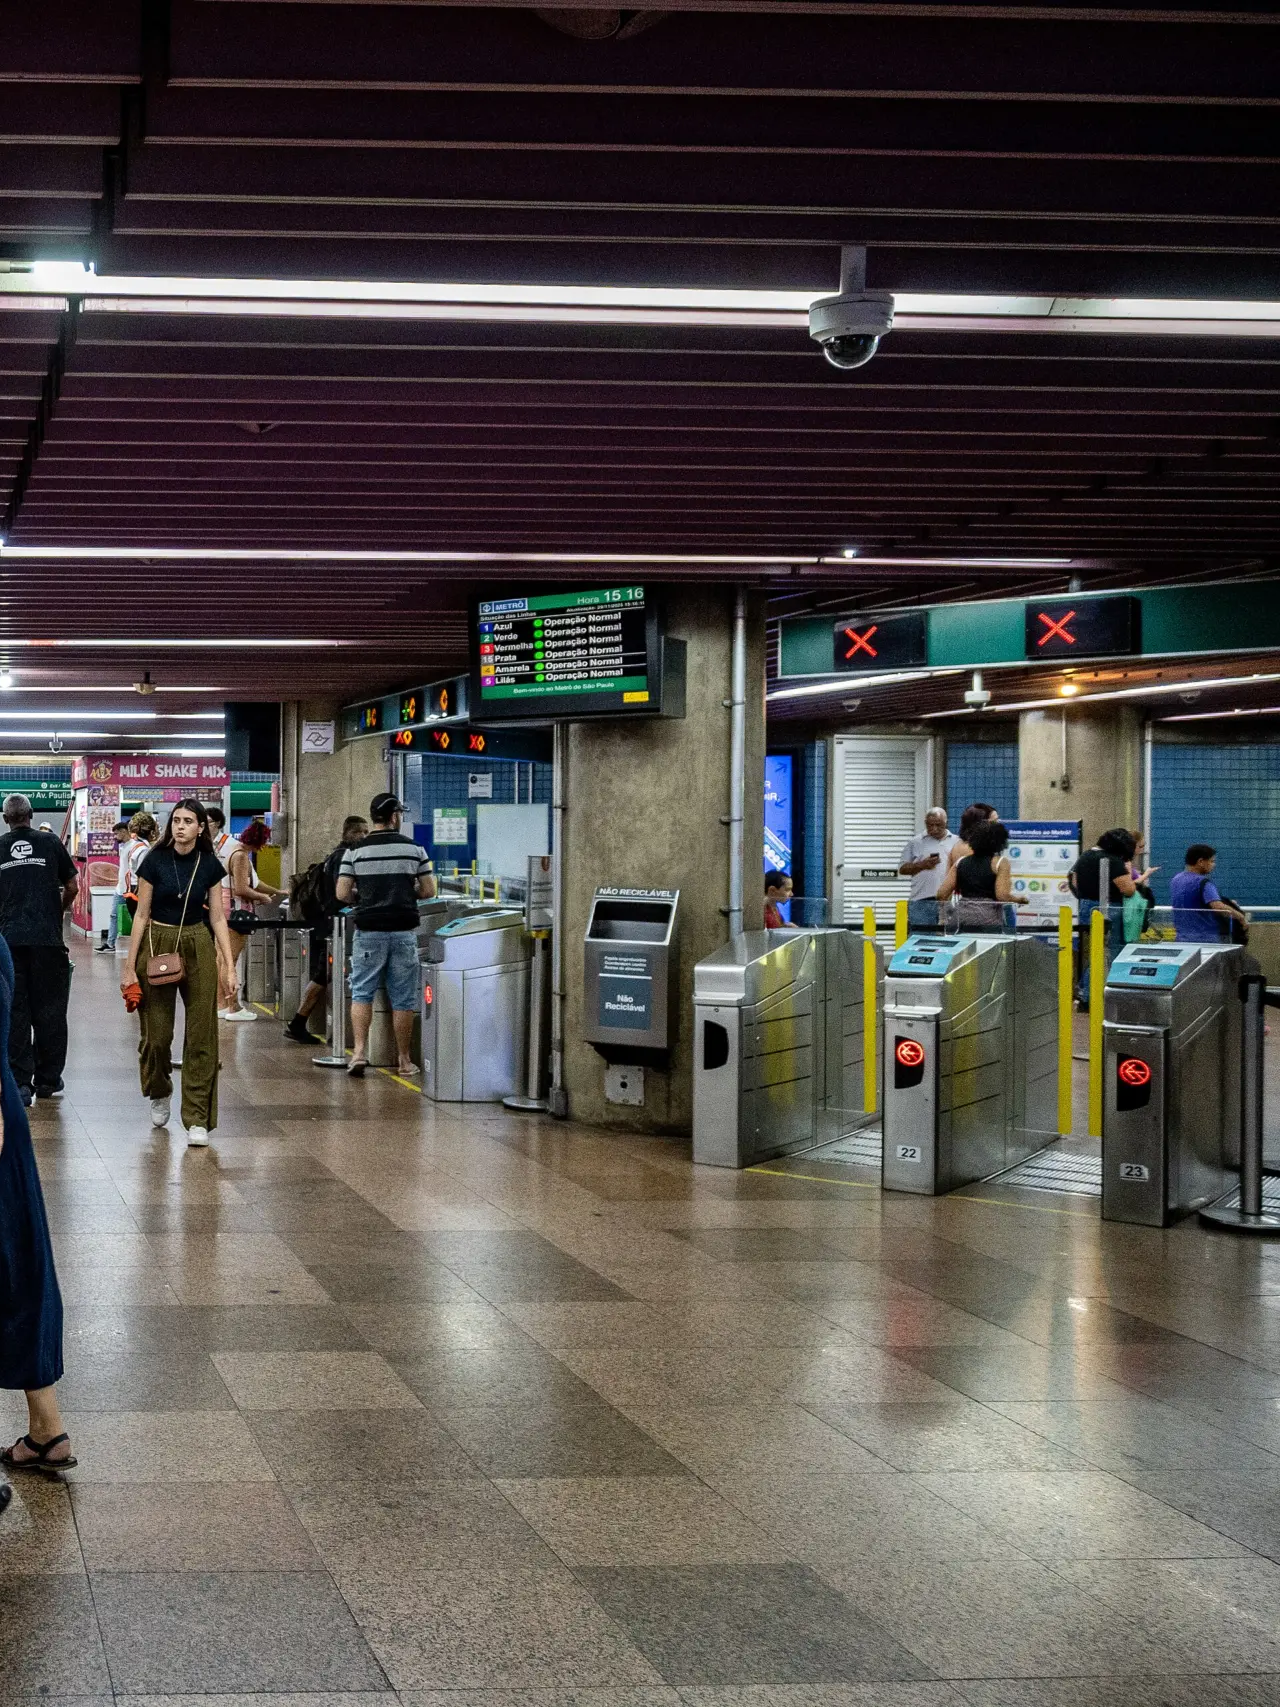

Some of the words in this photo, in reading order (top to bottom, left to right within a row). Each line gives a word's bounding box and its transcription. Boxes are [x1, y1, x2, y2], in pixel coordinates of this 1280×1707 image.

[604, 590, 621, 602] 15
[627, 588, 644, 600] 16
[495, 600, 524, 611] METRÔ
[494, 622, 512, 631] Azul
[544, 616, 586, 627] Operação
[588, 612, 622, 622] Normal
[494, 633, 518, 641] Verde
[544, 627, 587, 638] Operação
[588, 623, 622, 633] Normal
[494, 643, 533, 652] Vermelha
[545, 638, 587, 648] Operação
[589, 634, 622, 644] Normal
[545, 648, 587, 659] Operação
[589, 645, 623, 655] Normal
[495, 664, 530, 673] Amarela
[545, 660, 588, 670] Operação
[589, 657, 623, 667] Normal
[495, 676, 516, 684] Lilás
[545, 671, 588, 681] Operação
[590, 668, 623, 678] Normal
[120, 764, 149, 777] MILK
[154, 764, 197, 778] SHAKE
[600, 887, 618, 895] NÃO
[620, 888, 671, 897] RECICLÁVEL
[617, 994, 633, 1003] Não
[605, 1002, 645, 1012] Reciclável
[901, 1147, 916, 1159] 22
[1125, 1165, 1143, 1177] 23
